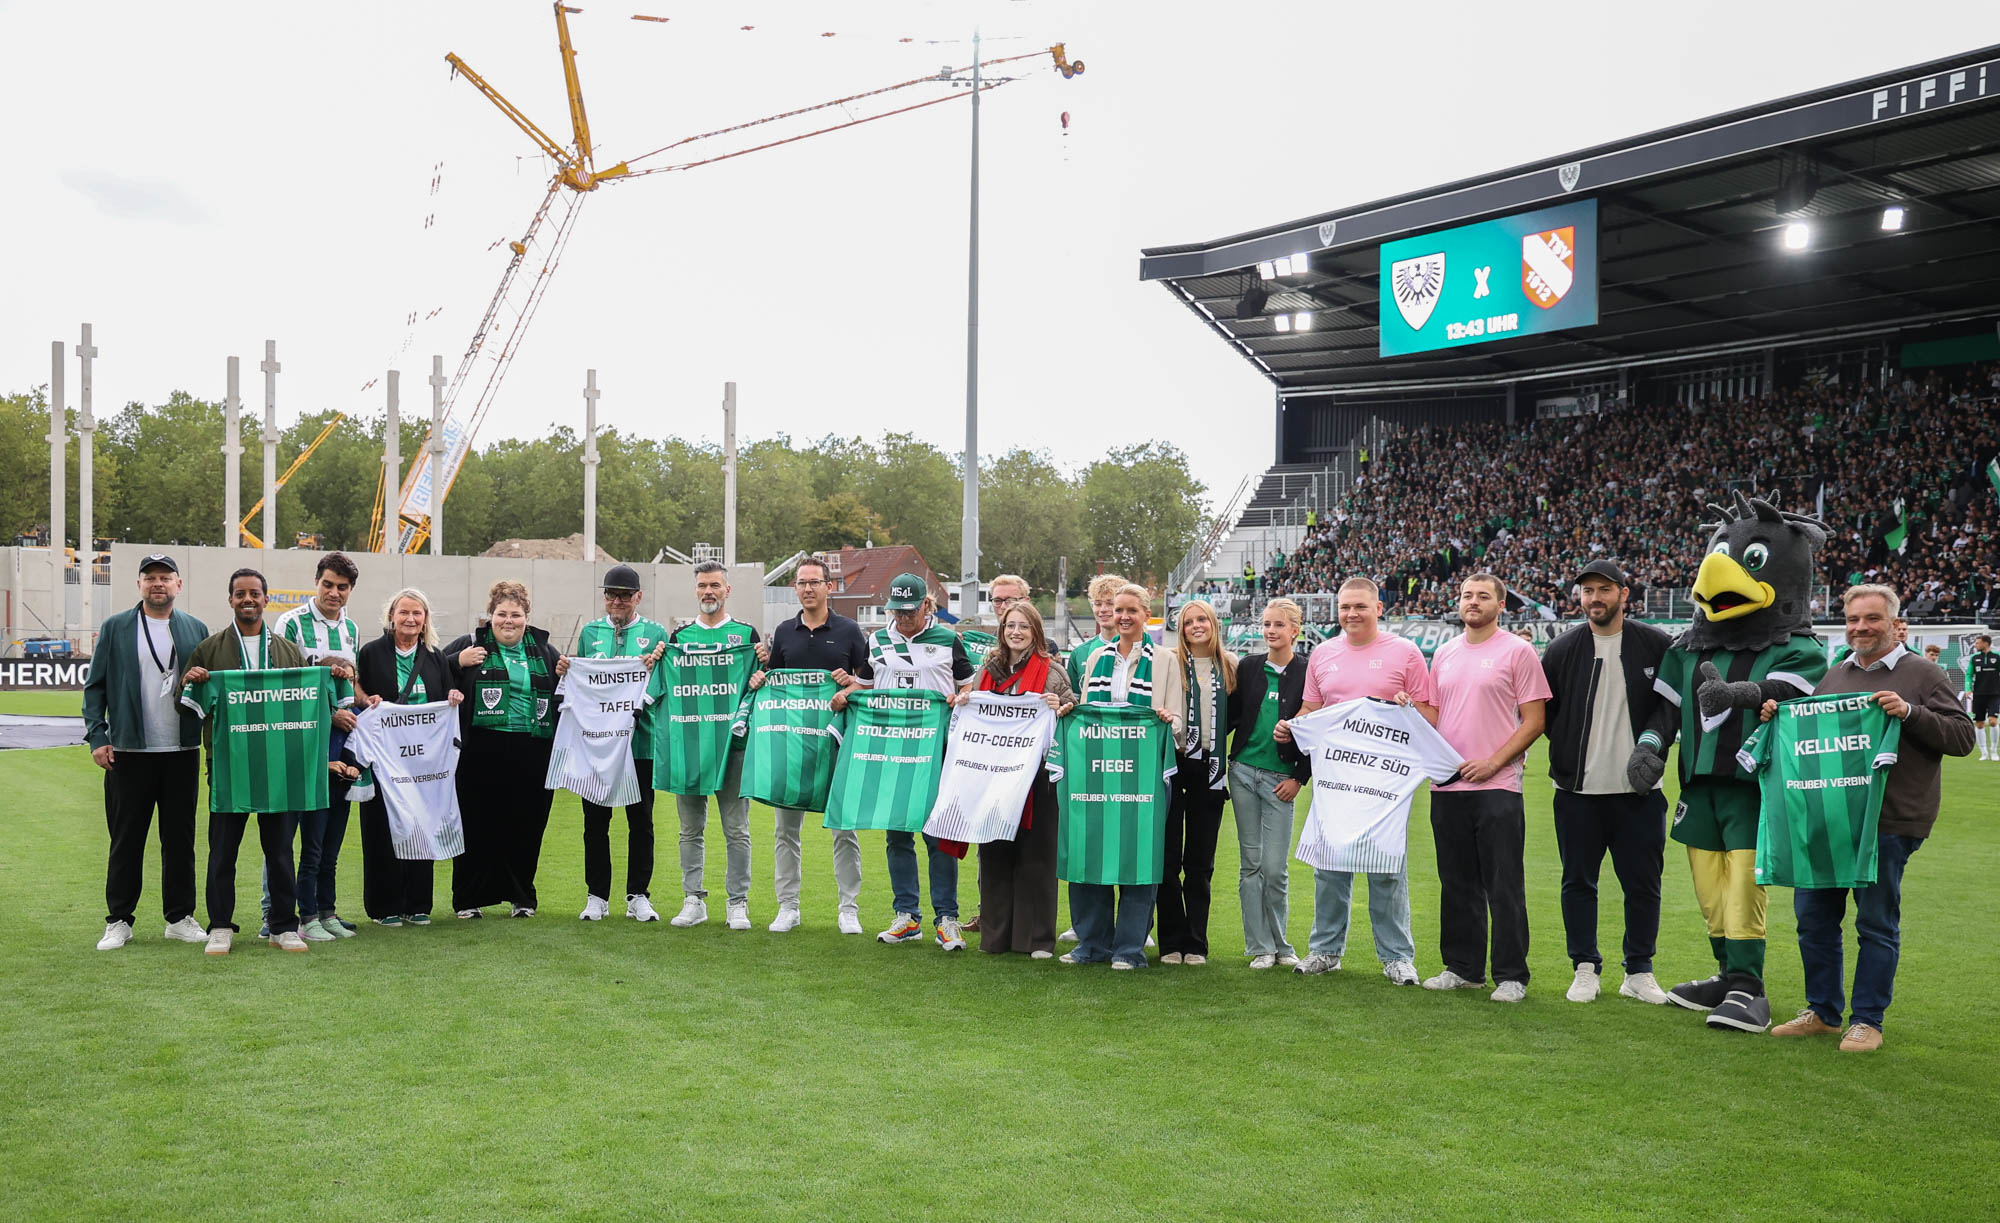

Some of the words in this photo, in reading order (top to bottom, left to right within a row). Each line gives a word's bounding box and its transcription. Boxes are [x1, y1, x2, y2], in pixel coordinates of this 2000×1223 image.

[1487, 313, 1518, 333] UHR
[270, 594, 312, 604] HELLM
[891, 586, 913, 599] MS4L
[673, 652, 734, 667] MÜNSTER
[589, 671, 647, 685] MÜNSTER
[765, 671, 826, 687] MÜNSTER
[228, 687, 318, 704] STADTWERKE
[673, 683, 738, 697] GORACON
[600, 700, 635, 713] TAFEL
[757, 698, 833, 712] VOLKSBANK
[867, 695, 931, 710] MÜNSTER
[271, 720, 318, 731] VERBINDET
[380, 712, 437, 728] MÜNSTER
[791, 726, 830, 737] VERBINDET
[857, 725, 937, 739] STOLZENHOFF
[1079, 723, 1147, 739] MÜNSTER
[1343, 718, 1410, 745] MÜNSTER
[963, 731, 1036, 748] HOT-COERDE
[1794, 734, 1872, 756] KELLNER
[400, 744, 425, 757] ZUE
[889, 755, 932, 763] VERBINDET
[1092, 759, 1134, 773] FIEGE
[1325, 748, 1378, 767] LORENZ
[1381, 759, 1411, 777] SÜD
[990, 763, 1024, 773] VERBINDET
[412, 770, 450, 784] VERBINDET
[1109, 793, 1154, 803] VERBINDET
[1353, 785, 1399, 802] VERBINDET
